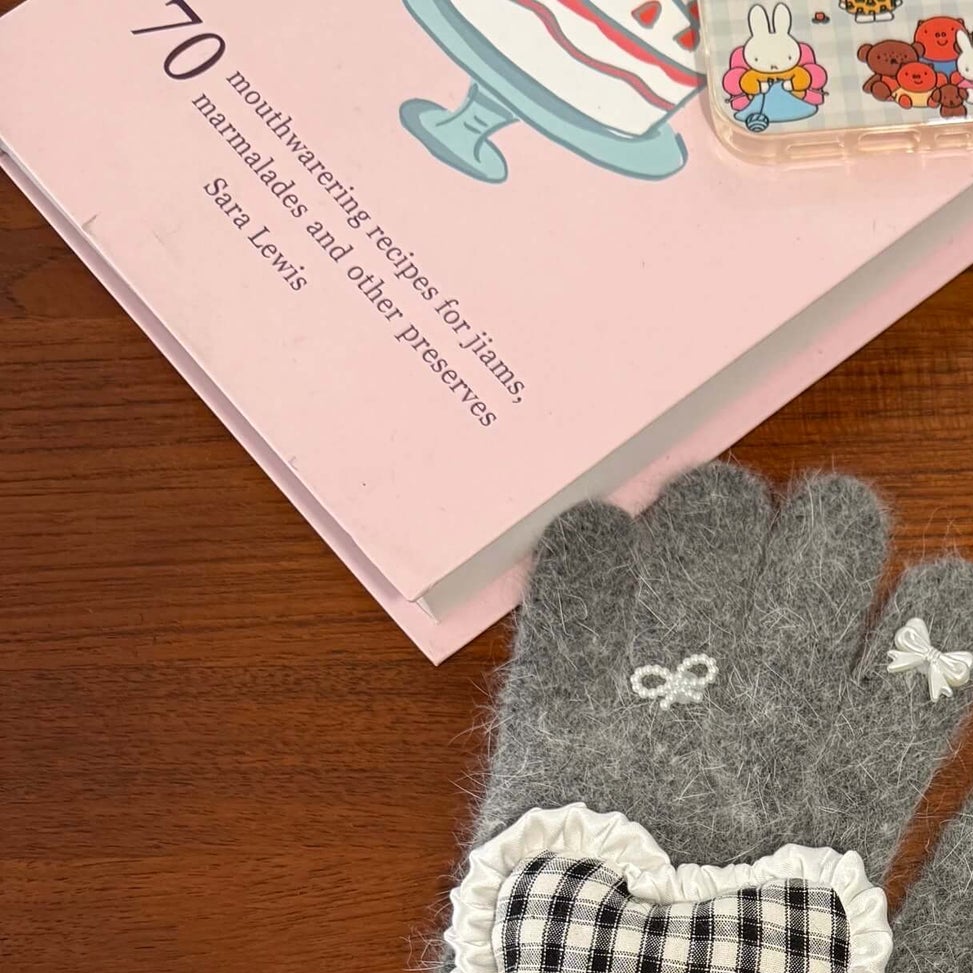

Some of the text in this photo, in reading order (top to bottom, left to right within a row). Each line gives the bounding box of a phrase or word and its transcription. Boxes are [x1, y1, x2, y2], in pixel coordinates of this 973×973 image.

[130, 0, 226, 80] 70
[191, 93, 497, 427] marmalades and other preserves
[203, 177, 308, 291] Sara Lewis
[225, 70, 525, 404] mouthwarering recipes for jiams,
